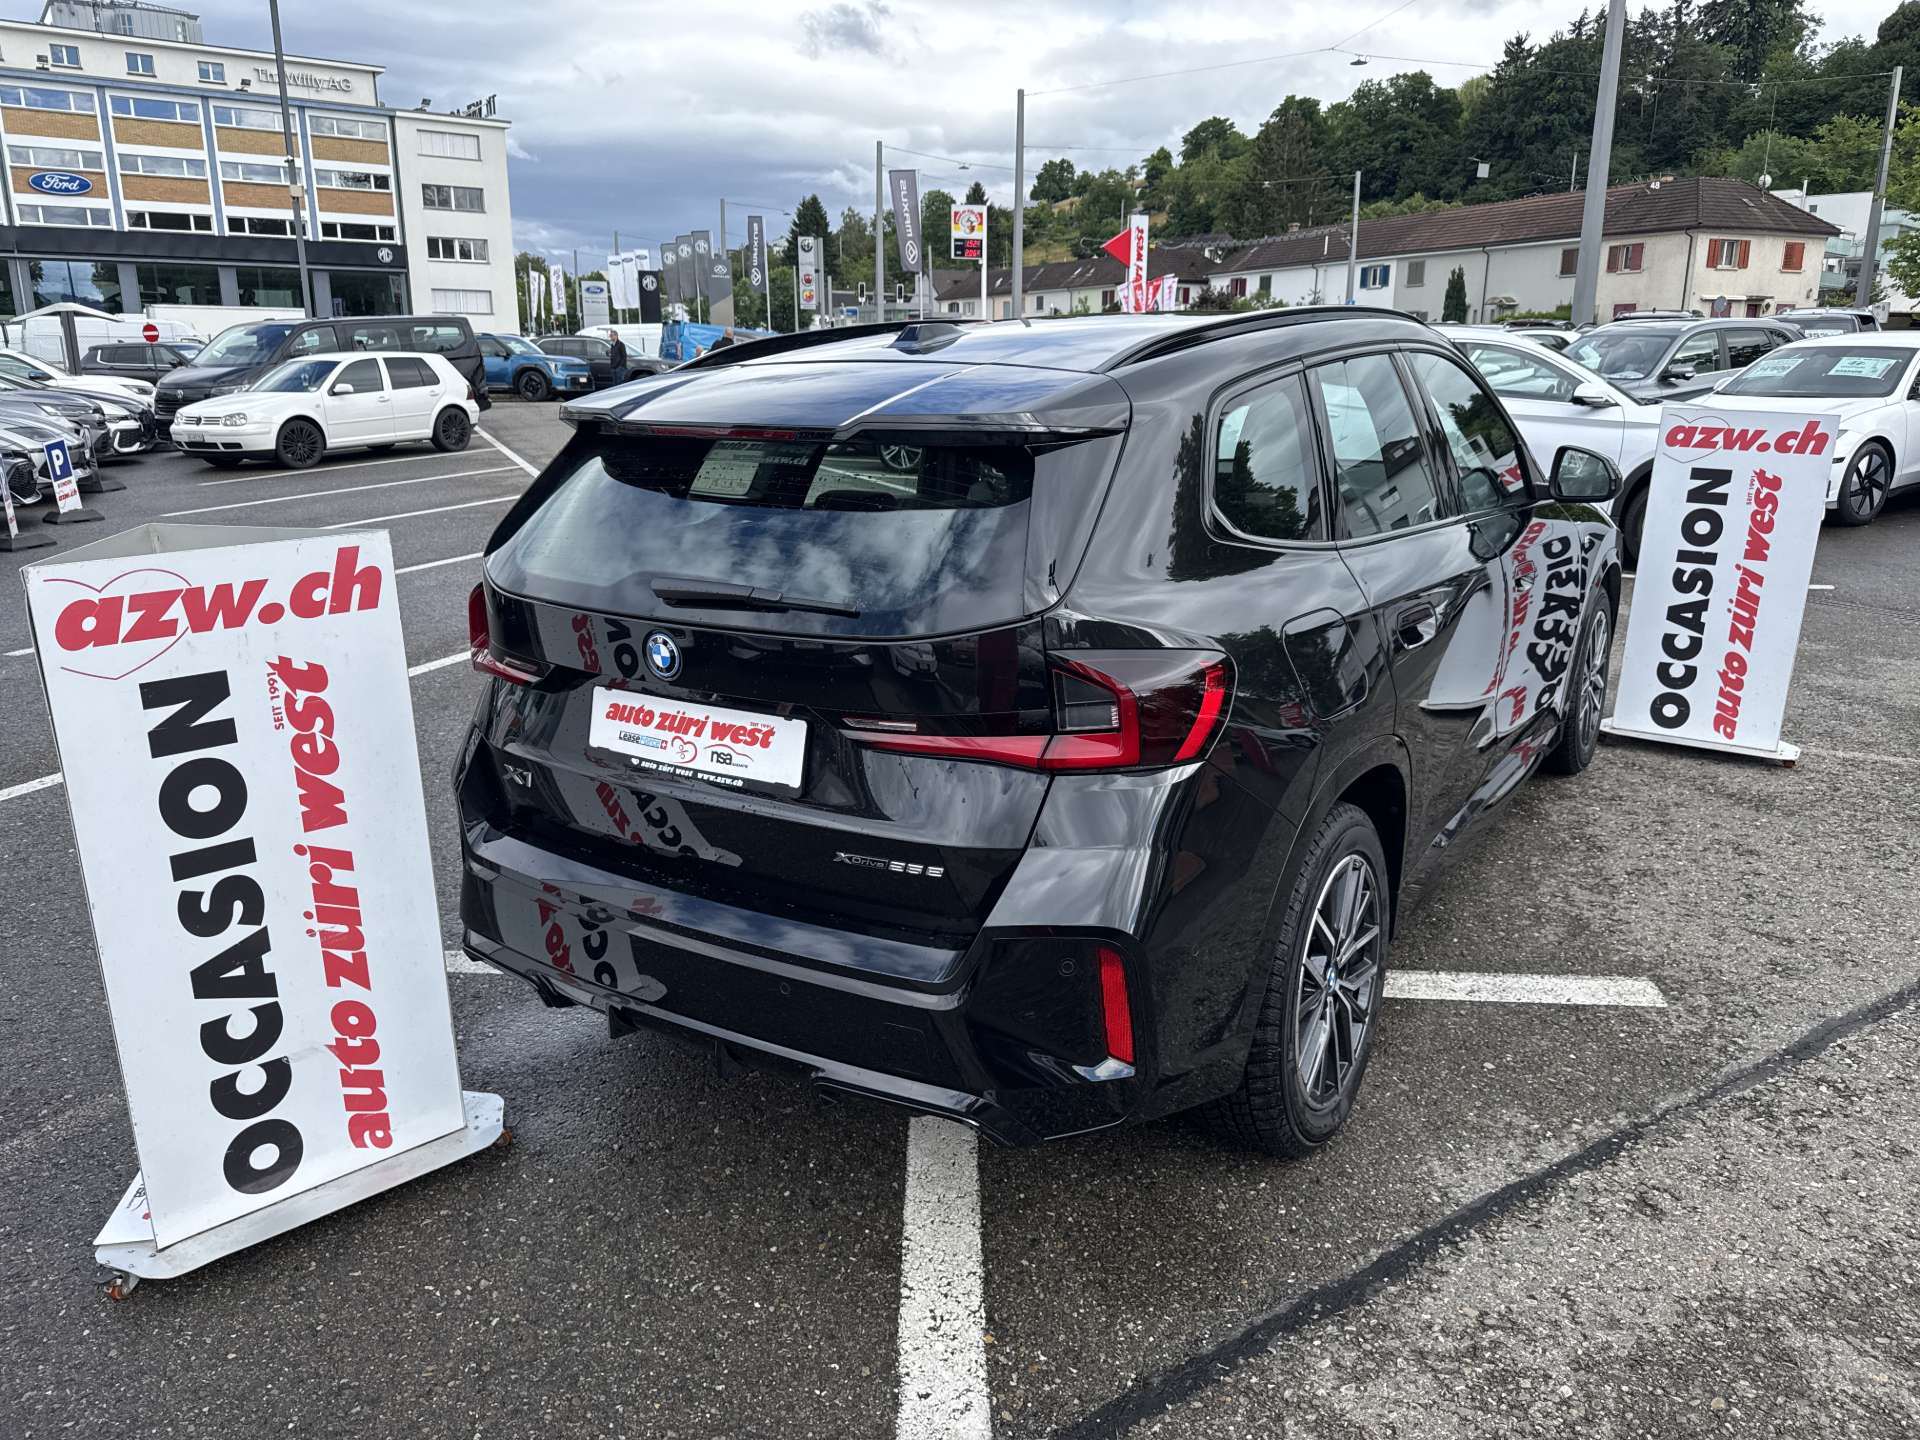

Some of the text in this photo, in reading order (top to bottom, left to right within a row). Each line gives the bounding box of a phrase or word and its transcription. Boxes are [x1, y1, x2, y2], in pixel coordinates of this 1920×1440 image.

[283, 71, 323, 92] Willy
[327, 76, 352, 92] AG
[42, 174, 80, 191] Ford
[1665, 420, 1830, 456] azw.ch
[50, 449, 64, 476] P
[54, 546, 383, 652] azw.ch
[1649, 467, 1733, 730] OCCASION
[1712, 468, 1783, 740] auto züri west
[266, 672, 285, 731] SEIT 1991
[606, 702, 776, 749] auto züri west
[503, 763, 532, 788] X1
[711, 751, 733, 765] nsa
[265, 655, 392, 1149] auto züri west
[138, 670, 304, 1195] OCCASION
